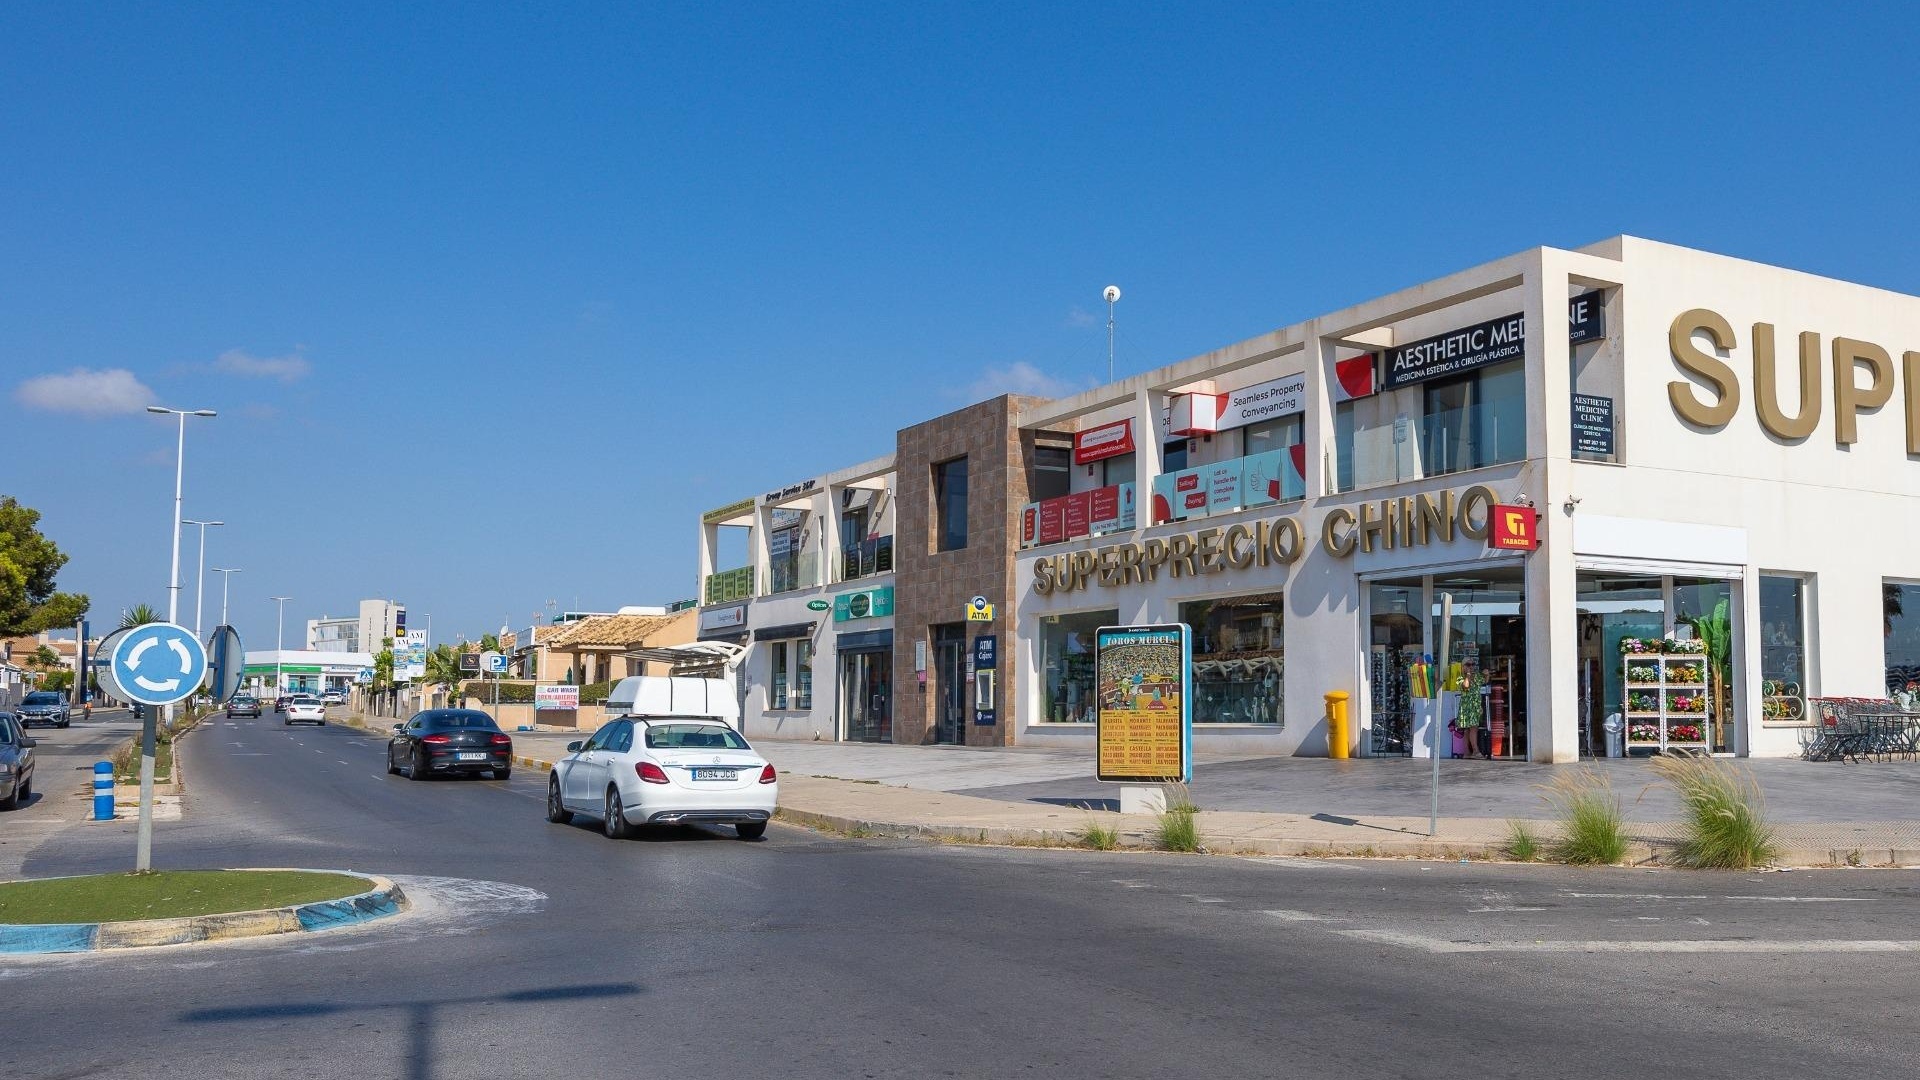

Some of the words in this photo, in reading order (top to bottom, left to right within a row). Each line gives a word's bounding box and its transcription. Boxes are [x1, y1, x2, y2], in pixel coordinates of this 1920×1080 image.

[1394, 329, 1484, 372] AESTHETIC
[1395, 370, 1426, 383] MEDICINA
[1454, 360, 1460, 368] &
[1460, 351, 1488, 367] CIRUGÍA
[1233, 391, 1269, 407] Seamless
[1270, 381, 1305, 398] Property
[1574, 397, 1611, 407] AESTHETIC
[1241, 398, 1296, 418] Conveyancing
[1575, 405, 1609, 415] MEDICINE
[1581, 414, 1604, 423] CLINIC
[782, 485, 801, 497] Service
[1033, 517, 1304, 595] SUPERPRECIO
[1322, 485, 1499, 558] CHINO
[1502, 537, 1529, 546] TABACOS
[971, 612, 989, 620] ATM
[979, 640, 993, 650] ATM
[1106, 637, 1136, 645] TOROS
[1138, 635, 1175, 644] MURCIA
[697, 770, 718, 778] 8094
[720, 770, 736, 778] JCG
